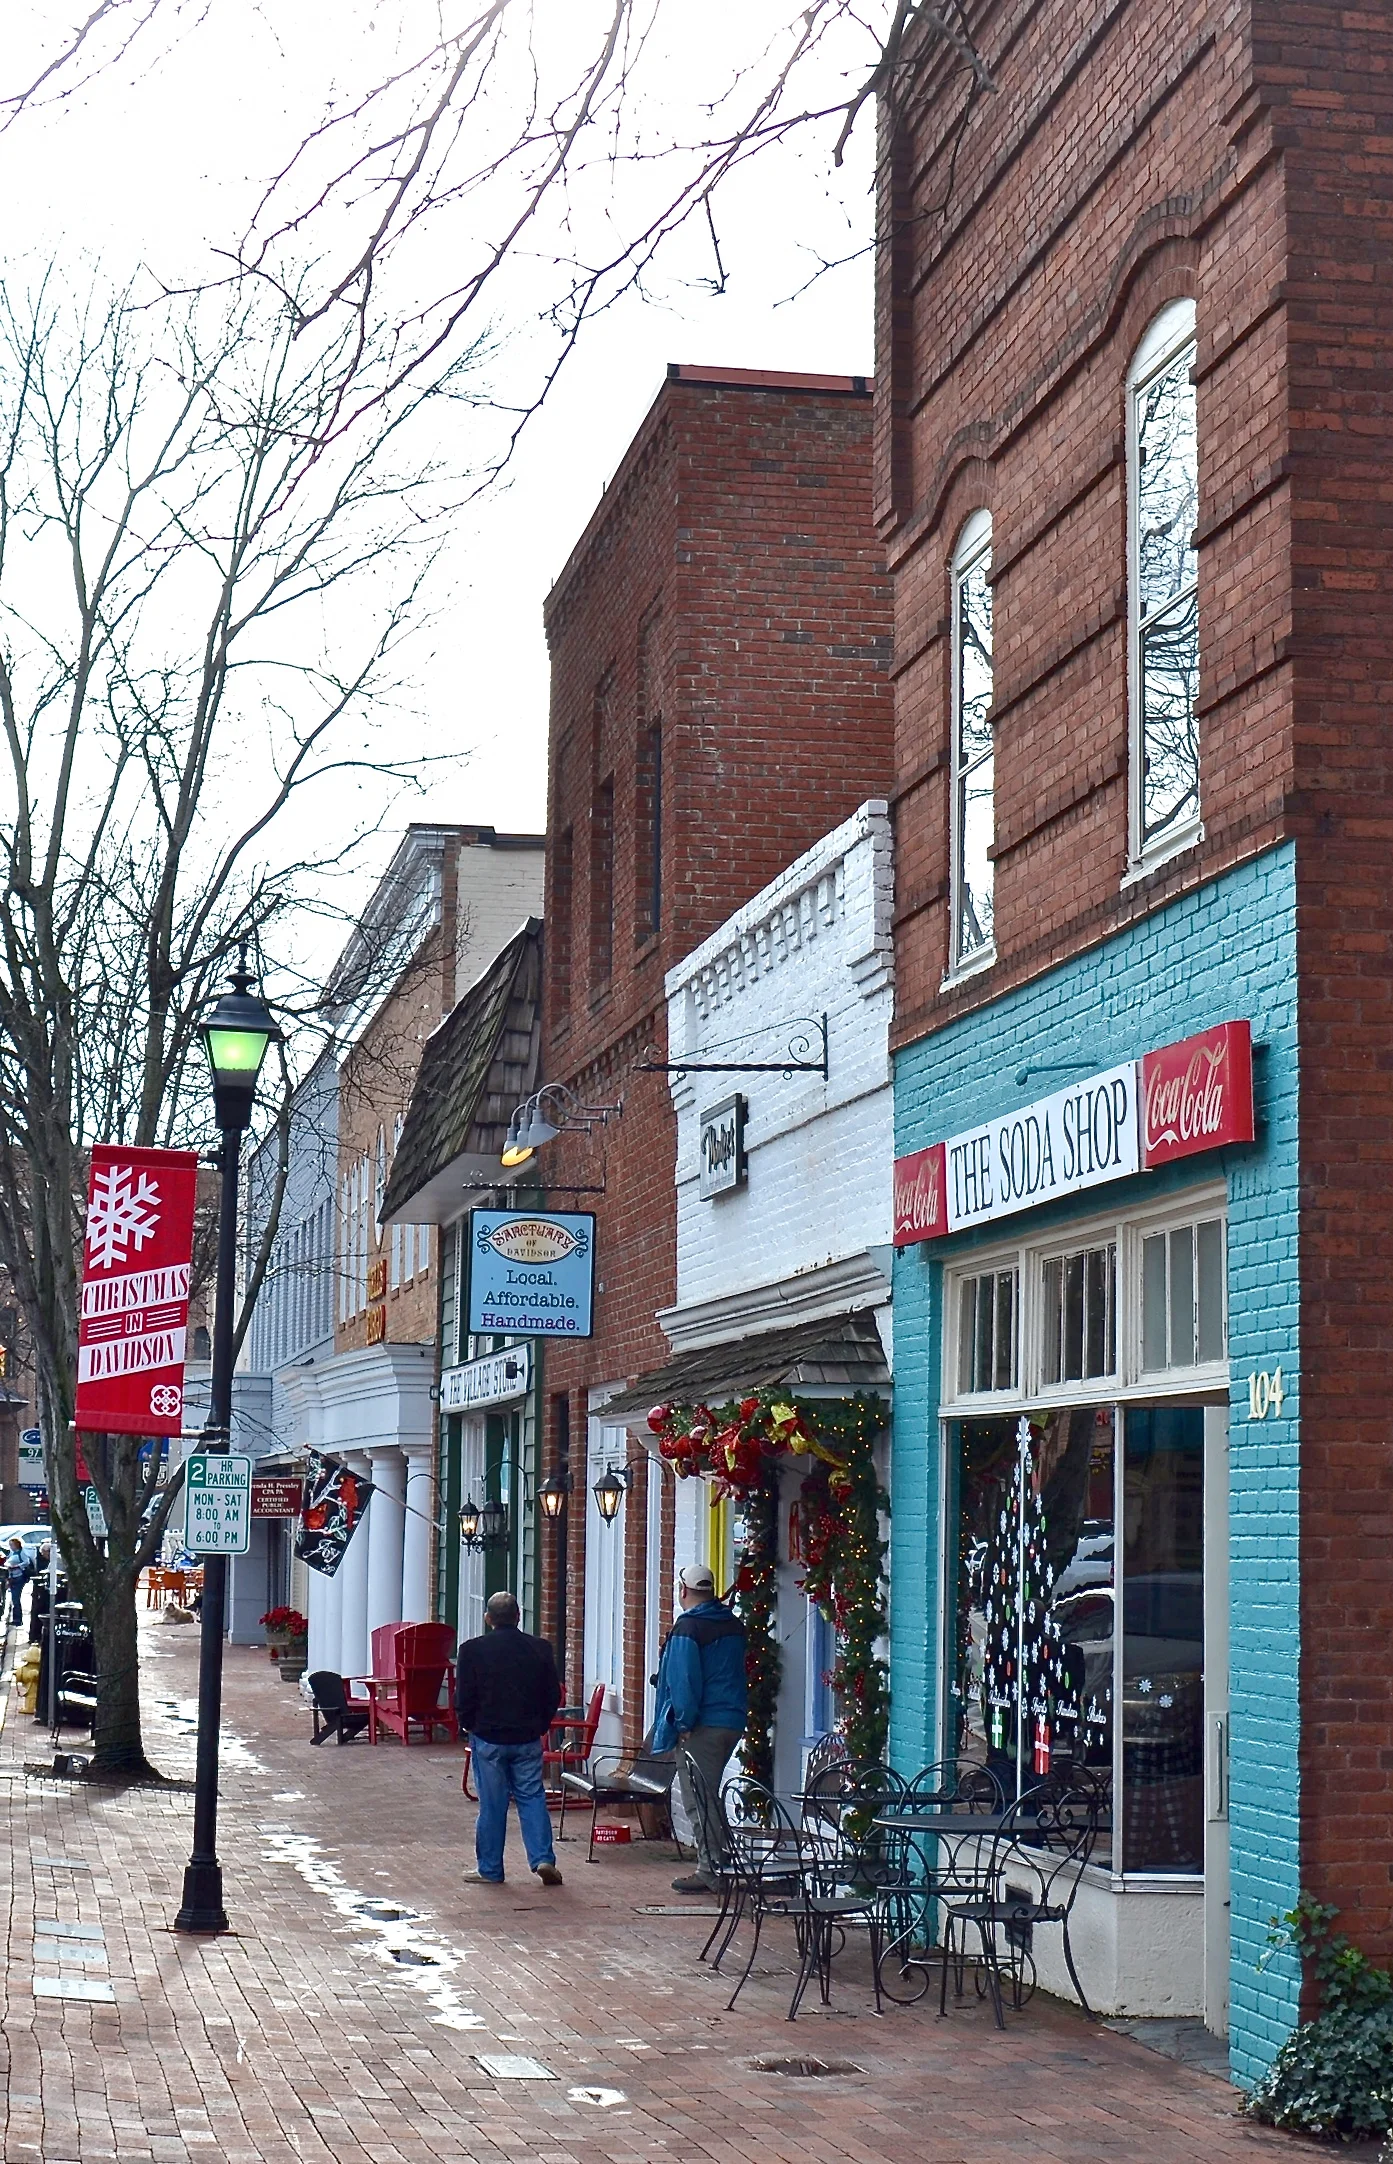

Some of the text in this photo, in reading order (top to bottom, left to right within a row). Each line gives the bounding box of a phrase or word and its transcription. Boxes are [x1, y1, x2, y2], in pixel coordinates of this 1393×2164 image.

[1144, 1041, 1228, 1152] Coca-Cola
[950, 1078, 1128, 1219] THE SODA SHOP
[492, 1224, 576, 1250] SANCTUARY
[525, 1240, 537, 1248] OF
[506, 1248, 557, 1258] DAVIDSON
[506, 1269, 558, 1286] Local.
[83, 1268, 189, 1315] CHRISTMAS
[482, 1290, 580, 1309] Affordable.
[125, 1311, 144, 1334] IN
[480, 1312, 580, 1331] Handmade.
[89, 1333, 177, 1377] DAVIDSON
[449, 1373, 462, 1405] THE
[463, 1364, 491, 1402] VILLAGE
[1247, 1365, 1284, 1419] 104
[27, 1448, 39, 1457] 97
[220, 1460, 233, 1472] HR
[207, 1473, 247, 1486] PARKING
[88, 1491, 96, 1501] 2
[194, 1493, 214, 1506] MON
[224, 1494, 242, 1507] SAT
[195, 1508, 239, 1522] 8:00 AM
[213, 1521, 221, 1530] TO
[195, 1530, 238, 1544] 6:00 PM
